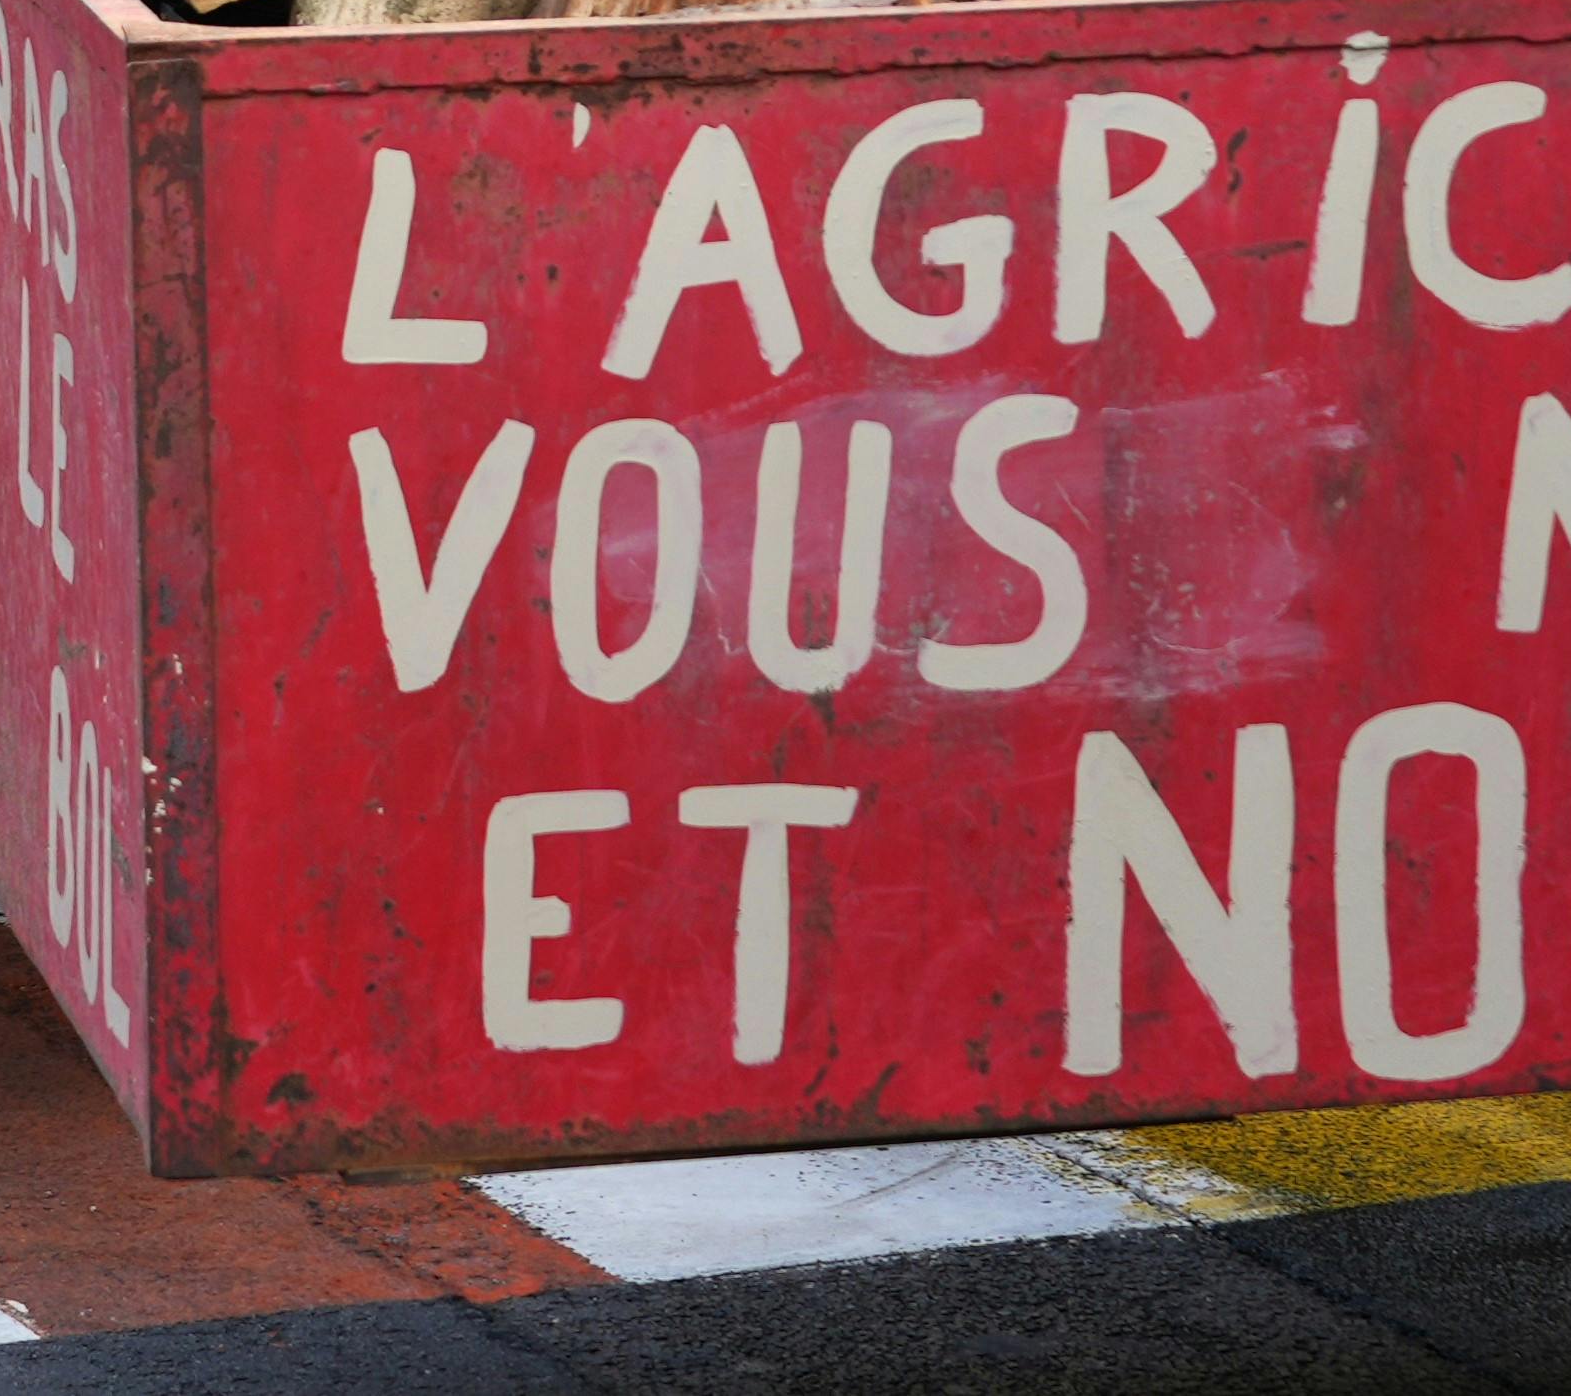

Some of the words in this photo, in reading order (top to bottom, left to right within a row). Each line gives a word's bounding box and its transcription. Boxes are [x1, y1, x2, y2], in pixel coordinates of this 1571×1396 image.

[17, 276, 75, 585] LE
[348, 394, 1089, 703] VOUS
[47, 664, 131, 1050] BOL
[481, 782, 860, 1066] ET
